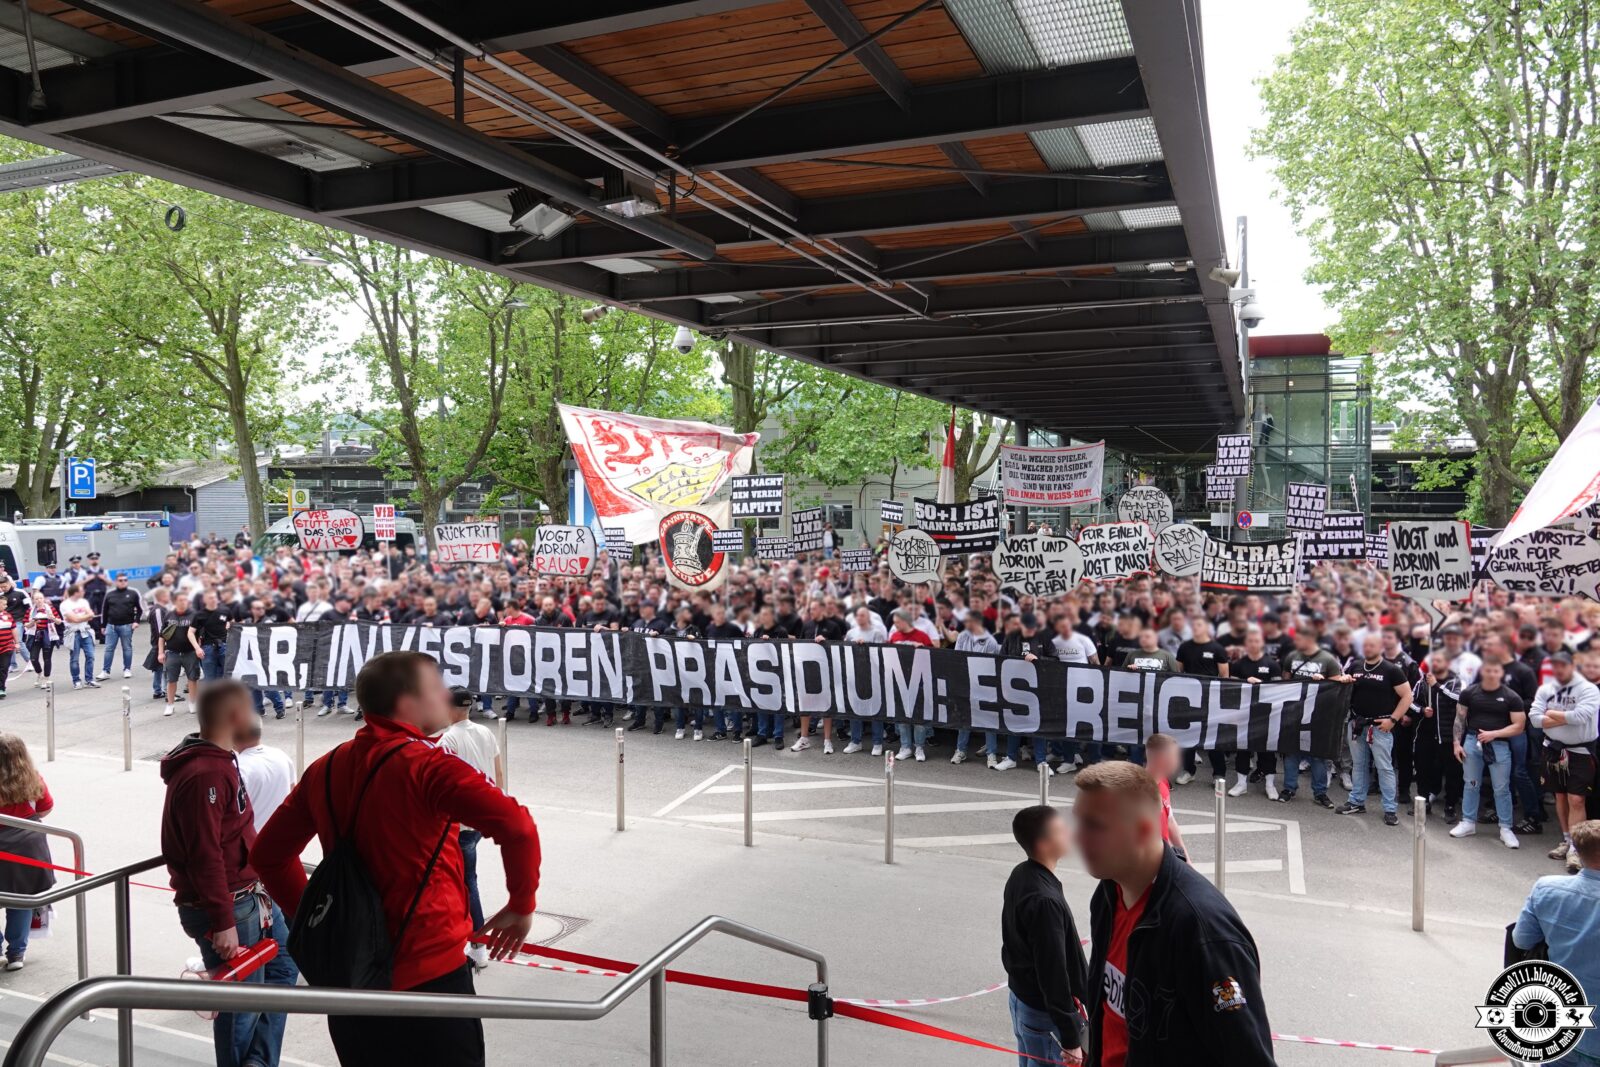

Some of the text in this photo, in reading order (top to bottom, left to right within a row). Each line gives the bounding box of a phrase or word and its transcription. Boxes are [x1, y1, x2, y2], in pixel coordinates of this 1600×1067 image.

[1219, 436, 1250, 446] VOGT
[1029, 455, 1056, 463] WELCHE
[1218, 447, 1250, 458] UND
[1021, 463, 1053, 472] WELCHER
[1216, 466, 1249, 475] RAUS
[733, 477, 783, 488] IHR MACHT
[1047, 472, 1087, 481] KONSTANTE
[1023, 482, 1037, 490] SIND
[1054, 482, 1074, 490] FANS!
[1290, 485, 1326, 498] VOGT
[733, 489, 783, 499] DEN VEREIN
[1007, 487, 1092, 500] FÜR IMMER WEISS-ROT!
[1207, 491, 1235, 499] RAUS
[733, 501, 782, 514] KAPUTT
[1289, 496, 1325, 510] UND
[375, 506, 394, 518] VfB
[793, 509, 821, 523] VOGT
[881, 510, 903, 521] JETZT
[914, 499, 998, 521] 50+1 IST
[1288, 509, 1324, 519] ADRION
[295, 518, 357, 528] STUTTGART
[793, 521, 822, 535] UND
[1286, 517, 1323, 530] RAUS
[305, 528, 352, 536] DAS SIND
[376, 529, 395, 538] WIR
[538, 528, 586, 543] VOGT &
[1082, 525, 1143, 541] FÜR EINEN
[1320, 530, 1364, 539] VEREIN
[1391, 525, 1429, 550] VOGT
[1434, 526, 1459, 548] und
[438, 542, 502, 560] JETZT!
[795, 540, 823, 552] RAUS
[1003, 538, 1038, 553] VOGT
[1042, 540, 1068, 553] UND
[1204, 541, 1296, 562] ULTRAS
[1302, 543, 1364, 556] APUTT
[758, 550, 788, 559] MAUL
[1161, 543, 1202, 567] RAUS
[1526, 546, 1563, 561] FÜR
[536, 557, 590, 575] RAUS!
[843, 562, 872, 571] MAUL
[999, 553, 1046, 569] ADRION
[1115, 552, 1151, 573] RAUS!
[1203, 556, 1294, 575] BEDEUTET
[1393, 553, 1440, 572] ADRION
[671, 567, 716, 585] KURVE
[1001, 569, 1067, 583] ZEIT ZU
[1393, 574, 1421, 592] ZEIT
[1436, 571, 1471, 593] GEHN!
[1502, 579, 1536, 593] DES
[231, 626, 308, 691] AR,
[645, 637, 948, 724] PRÄSIDIUM:
[967, 656, 1041, 734] ES
[1066, 667, 1319, 753] REICHT!
